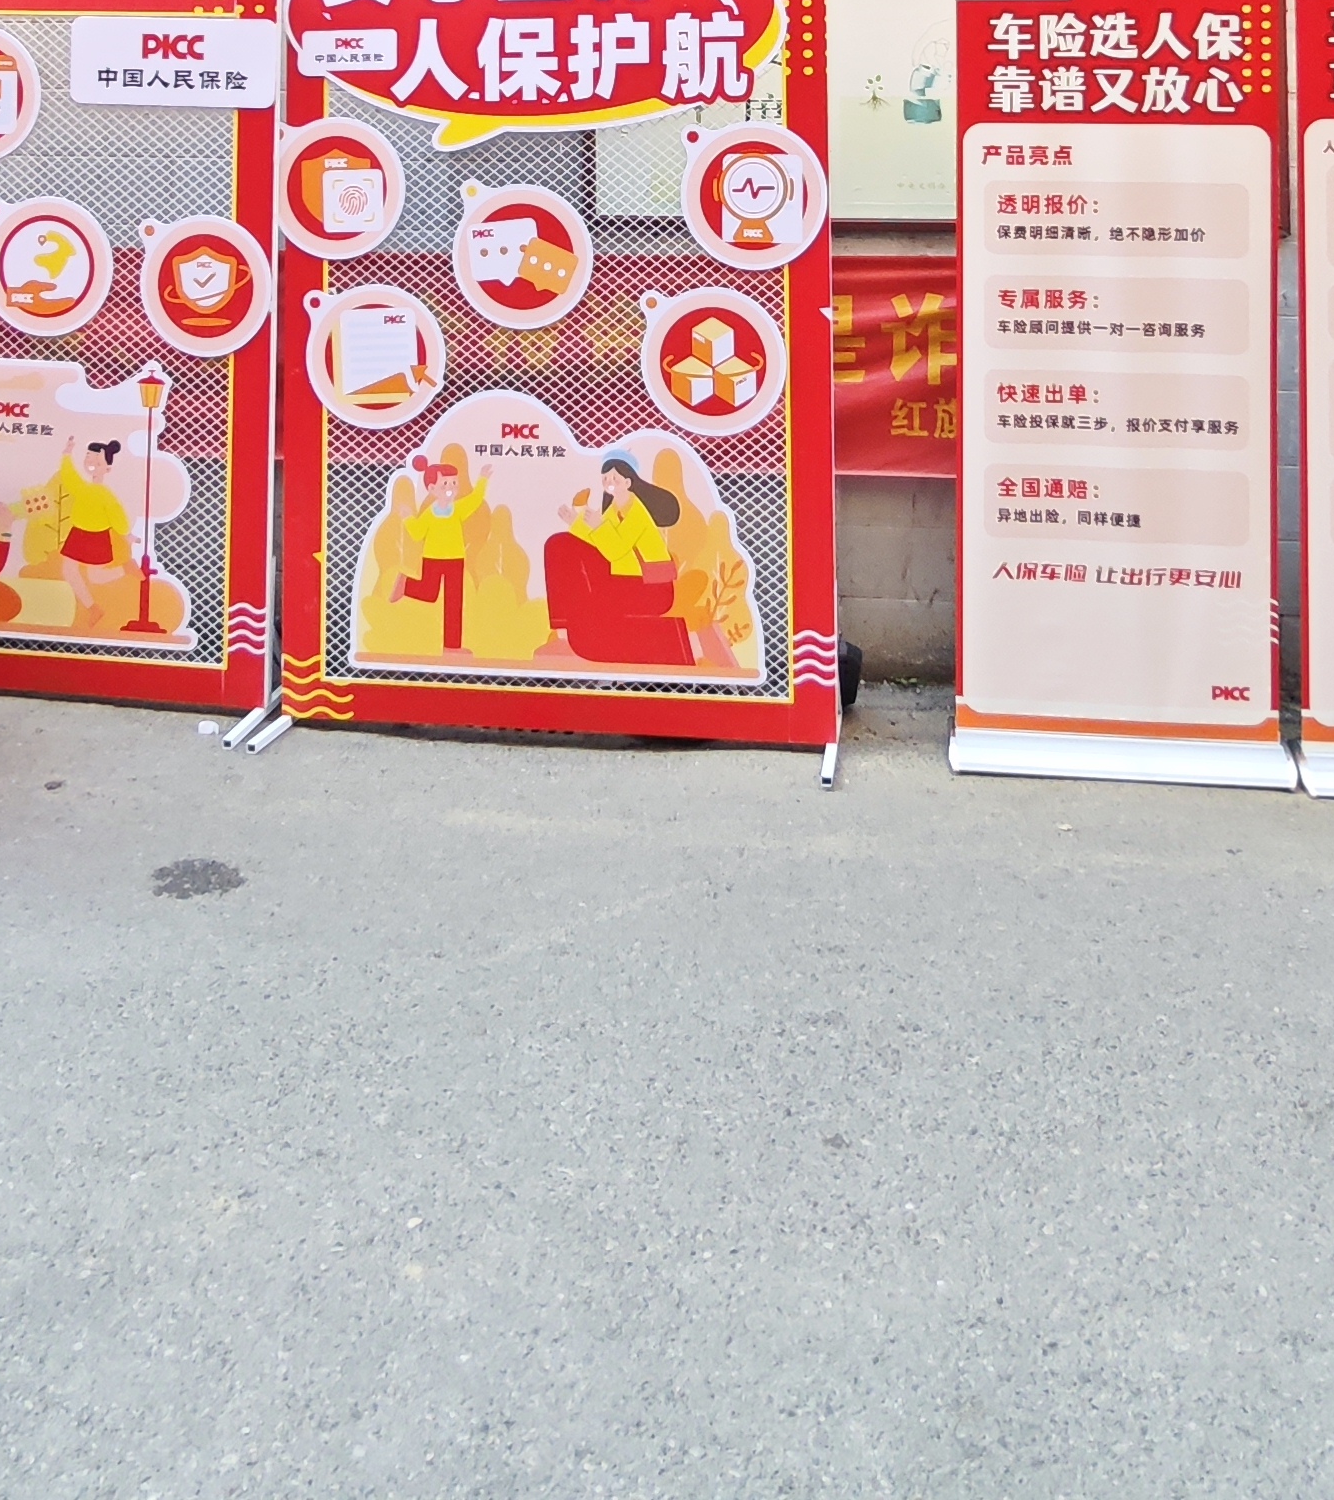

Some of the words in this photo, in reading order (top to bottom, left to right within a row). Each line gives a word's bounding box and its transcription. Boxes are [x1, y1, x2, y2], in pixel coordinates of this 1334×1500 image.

[335, 37, 364, 50] PICC
[987, 12, 1244, 60] 车险选人保
[141, 34, 204, 60] PICC
[390, 10, 748, 102] 人保护航
[314, 52, 385, 63] 中国人民保险
[97, 67, 248, 91] 中国人民保险
[987, 66, 1244, 114] 靠谱又放心
[981, 145, 1073, 166] 产品亮点
[472, 227, 494, 239] PICC
[384, 313, 406, 324] PICC
[997, 319, 1206, 339] 车险顾问提供一对一咨询服务
[501, 423, 540, 439] PICC
[474, 443, 566, 458] 中国人民保险
[992, 562, 1087, 583] 人保车险
[1095, 565, 1242, 589] 让出行更安心
[1212, 685, 1250, 701] PICC
